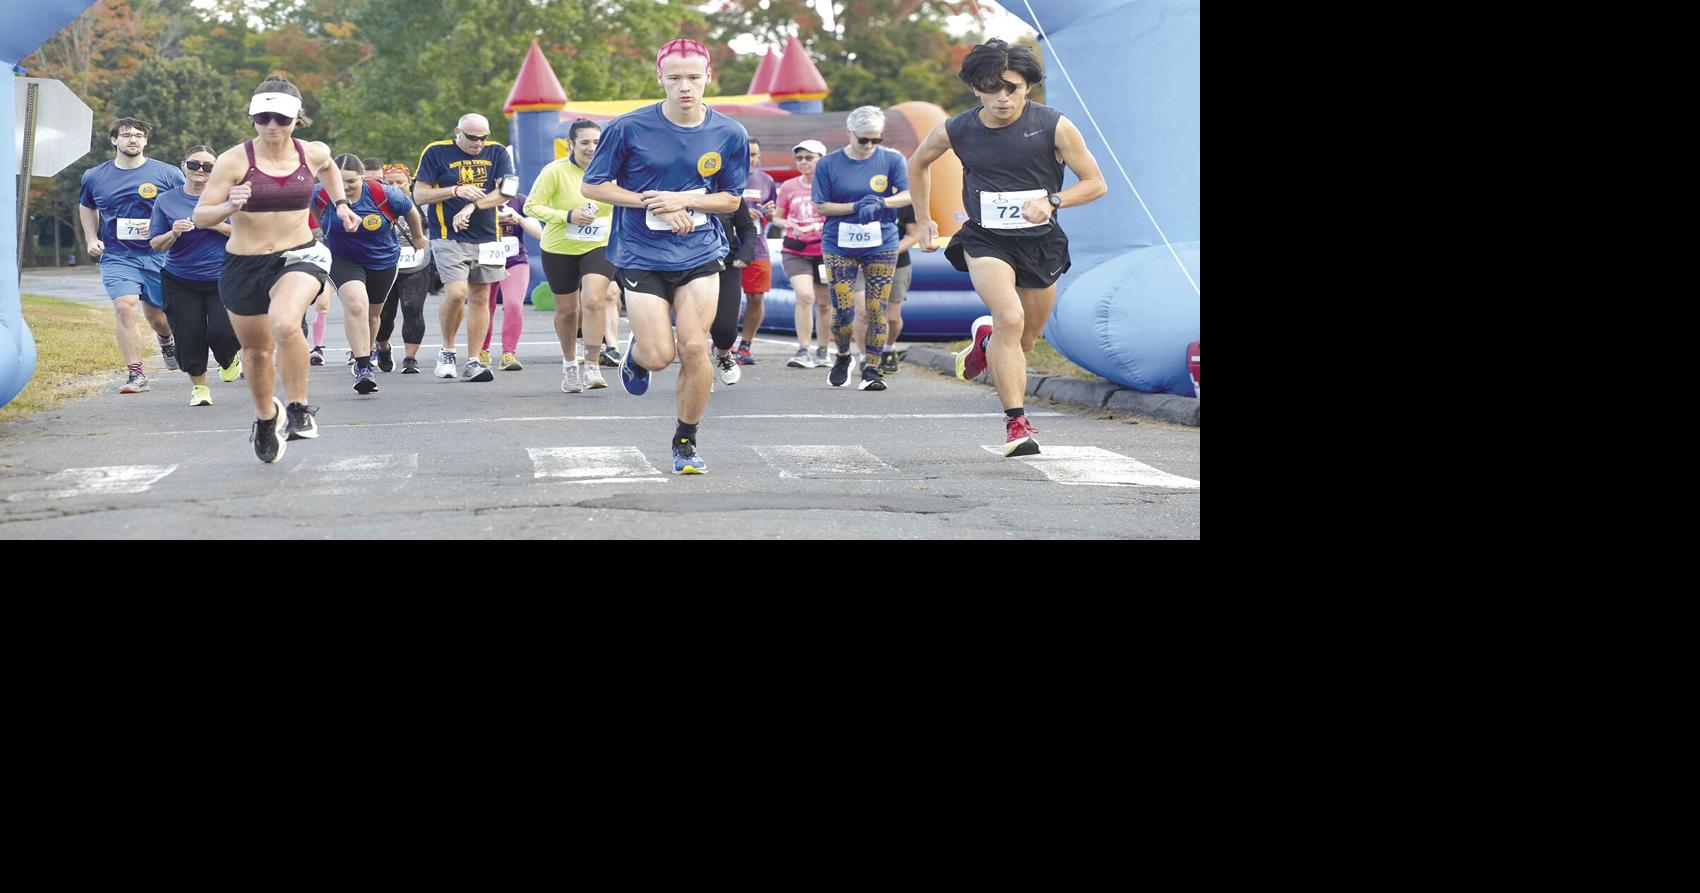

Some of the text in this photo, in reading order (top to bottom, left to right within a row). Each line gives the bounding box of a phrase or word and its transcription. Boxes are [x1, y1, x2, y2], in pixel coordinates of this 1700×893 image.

[996, 205, 1024, 219] 72
[127, 226, 140, 235] 71
[577, 225, 600, 235] 707
[848, 232, 871, 241] 705
[399, 254, 416, 262] 721
[489, 250, 505, 259] 701
